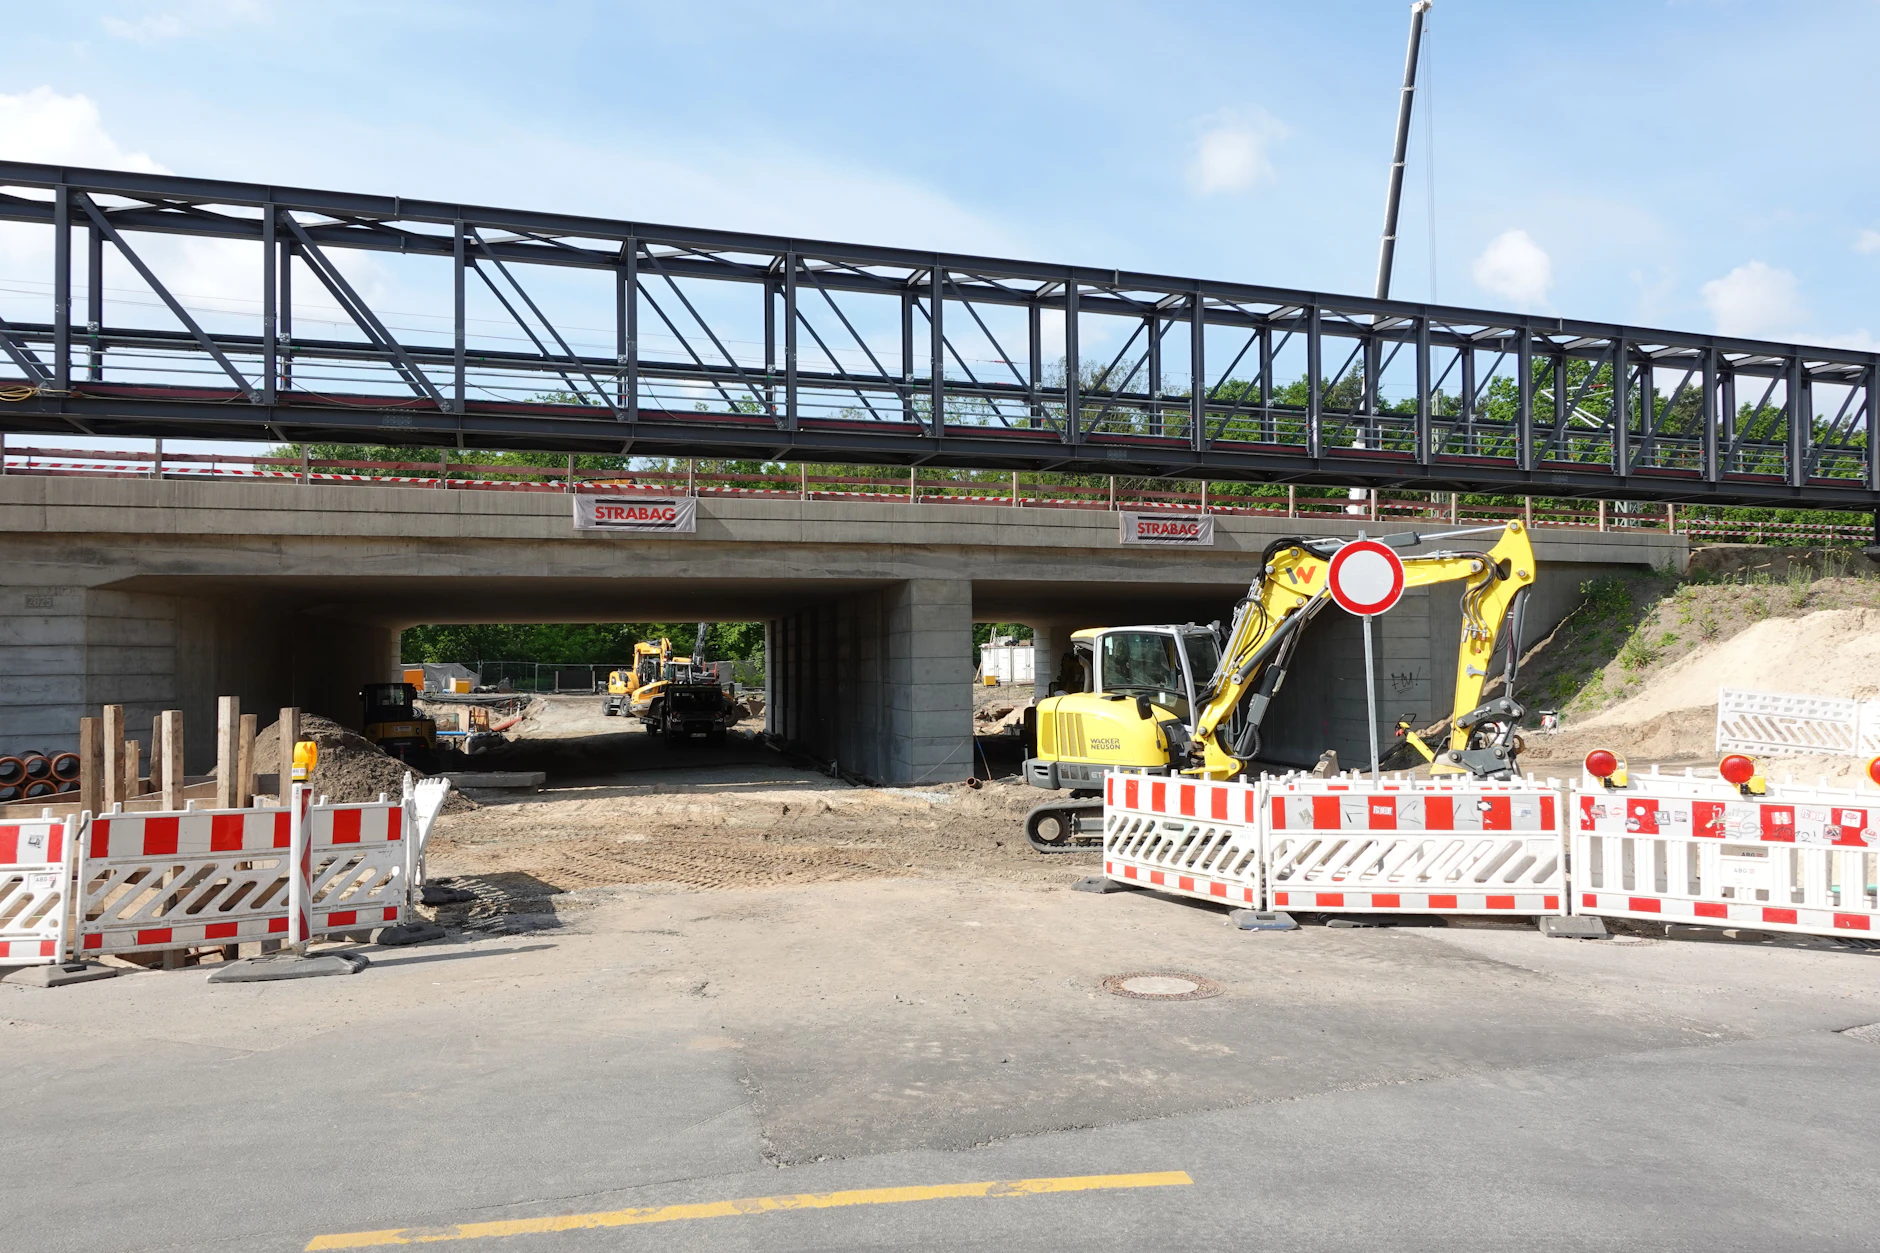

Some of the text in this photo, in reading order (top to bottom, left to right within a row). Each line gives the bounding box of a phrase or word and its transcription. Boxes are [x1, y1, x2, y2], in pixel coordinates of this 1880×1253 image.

[595, 506, 676, 521] STRABAG
[1137, 522, 1199, 535] STRABAG
[27, 596, 52, 607] 2025
